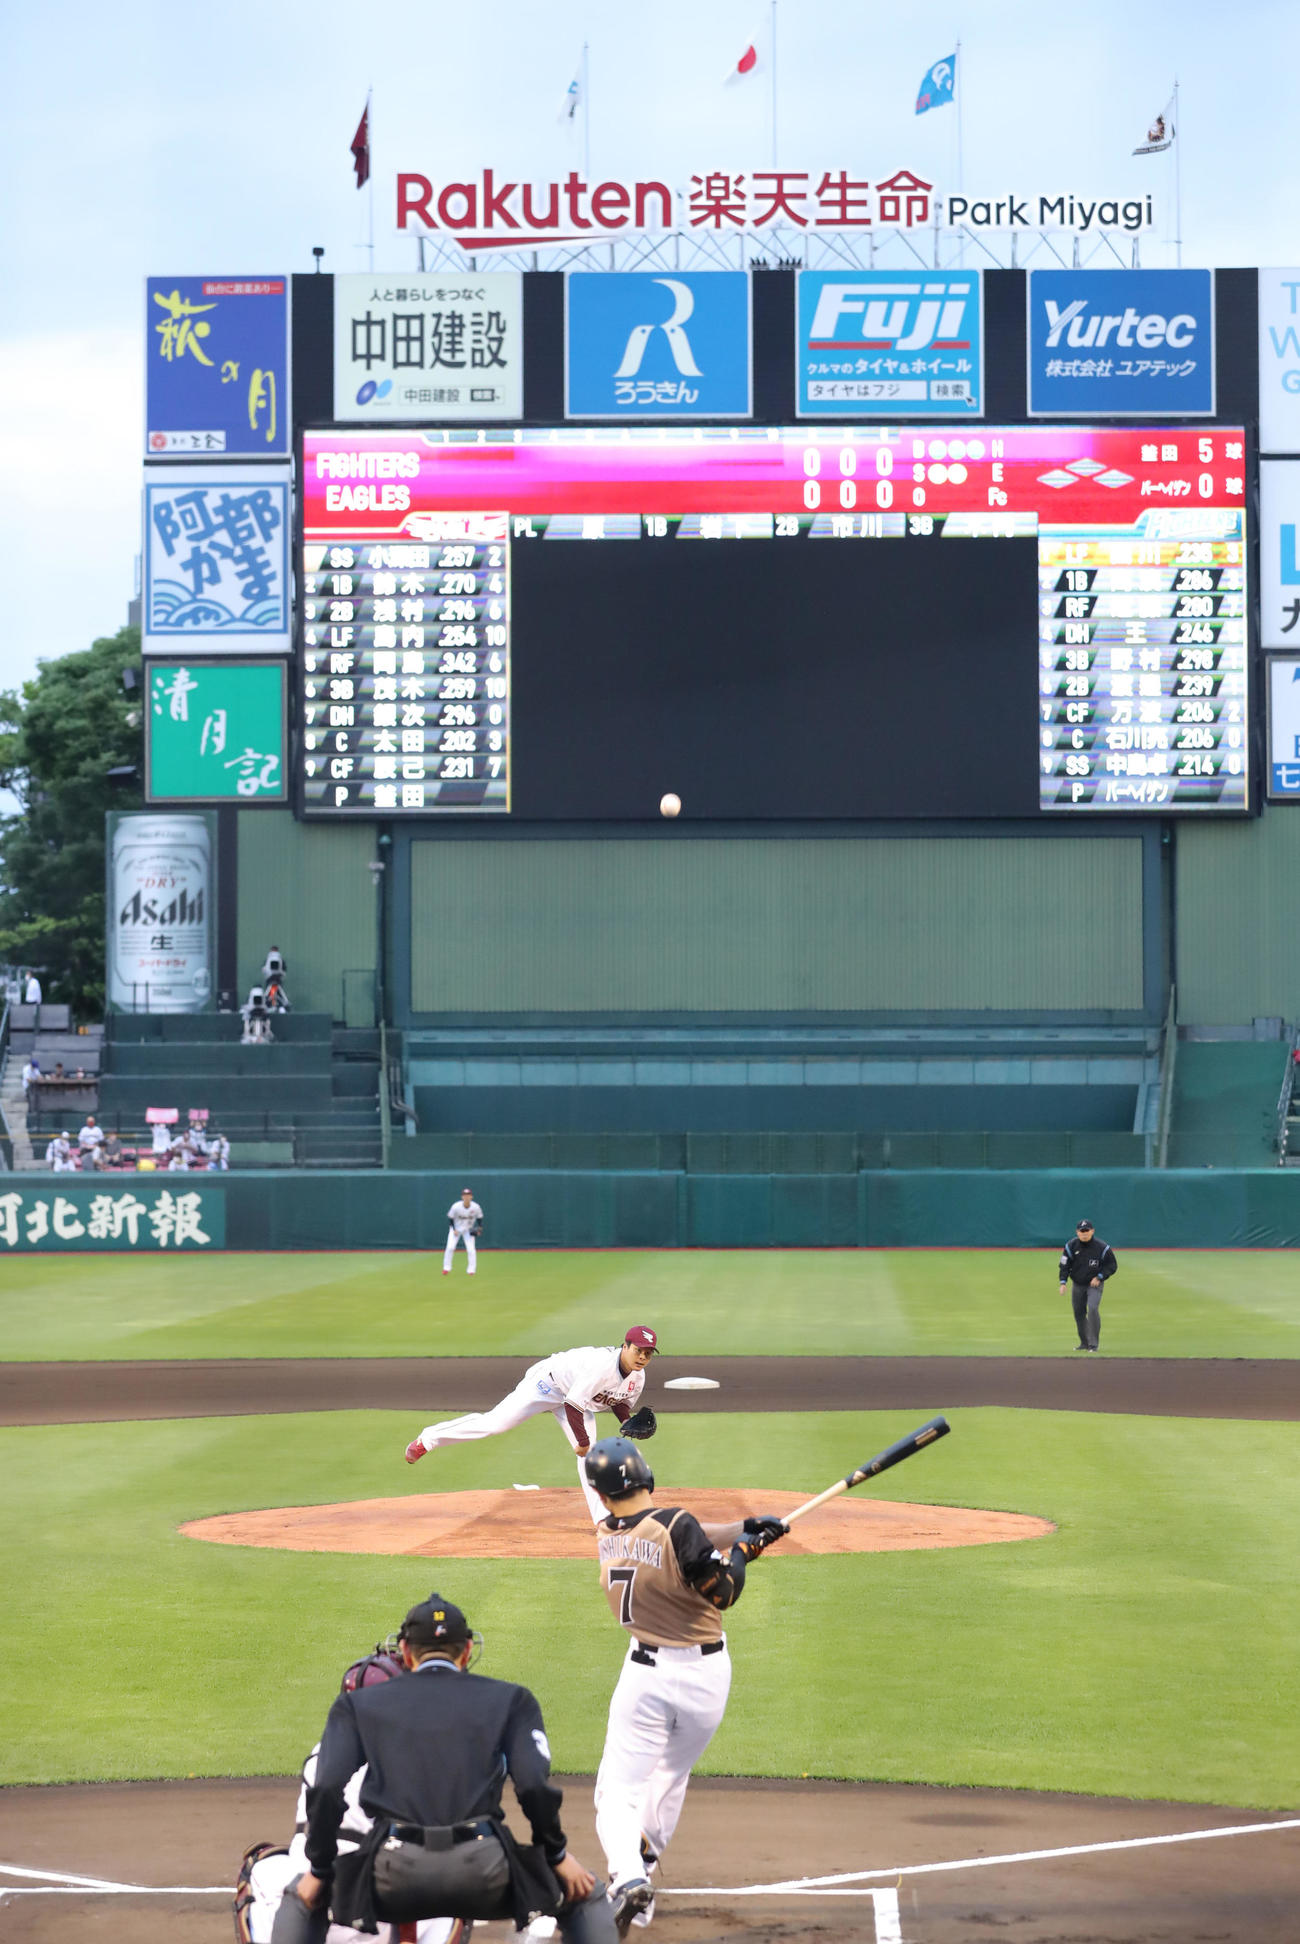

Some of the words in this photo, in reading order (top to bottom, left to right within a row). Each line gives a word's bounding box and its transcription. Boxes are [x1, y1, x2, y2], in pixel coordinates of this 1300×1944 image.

[396, 168, 672, 229] Rakuten
[689, 170, 933, 229] 楽天生命
[948, 196, 1029, 226] Park
[1039, 194, 1153, 231] Miyagi
[370, 288, 486, 302] 人と暮らしをつなぐ
[810, 284, 971, 351] Fuji
[1044, 300, 1197, 348] Yurtec
[351, 310, 508, 371] 中田建設
[1045, 359, 1114, 378] 株式会社
[1115, 359, 1197, 377] ユアテック
[404, 388, 460, 403] 中田建設
[614, 380, 700, 405] ろうきん
[812, 383, 901, 397] タイヤはフジ
[936, 384, 964, 397] 検索
[991, 439, 1004, 458] H
[1198, 438, 1214, 464] 5
[316, 452, 420, 478] FIGHTERS
[803, 447, 821, 477] 0
[839, 447, 857, 477] 0
[876, 447, 894, 477] 0
[912, 463, 925, 482] S
[992, 462, 1004, 482] E
[803, 479, 821, 509] 0
[839, 479, 857, 509] 0
[876, 479, 894, 509] 0
[1198, 472, 1214, 499] 0
[326, 484, 410, 510] EAGLES
[153, 489, 281, 558] 阿部
[514, 517, 537, 537] PL
[645, 517, 668, 537] 1B
[909, 517, 934, 536] 3B
[330, 547, 354, 568] SS
[487, 545, 502, 567] 2
[180, 540, 278, 600] かま
[331, 574, 353, 595] 1B
[488, 572, 502, 594] 4
[1066, 571, 1087, 591] 1B
[488, 599, 502, 620] 6
[1066, 597, 1089, 617] RF
[331, 627, 353, 647] LF
[485, 626, 506, 646] 10
[1065, 623, 1089, 643] DH
[1125, 621, 1147, 643] 王
[330, 653, 354, 674] RF
[488, 652, 502, 673] 6
[1065, 650, 1089, 669] 3B
[485, 678, 506, 698] 10
[1066, 676, 1089, 696] 2B
[330, 706, 355, 726] DH
[488, 704, 502, 725] 0
[1066, 703, 1089, 723] CF
[152, 667, 280, 796] 清月記
[336, 732, 348, 752] C
[373, 729, 425, 752] 太田
[488, 730, 502, 751] 3
[1072, 729, 1083, 749] C
[331, 759, 354, 778] CF
[489, 756, 502, 777] 7
[1066, 755, 1089, 775] SS
[335, 786, 348, 807] P
[1072, 782, 1084, 802] P
[119, 887, 205, 927] Asahi
[150, 934, 174, 951] 生
[619, 1464, 627, 1478] 7
[607, 1565, 638, 1626] 7
